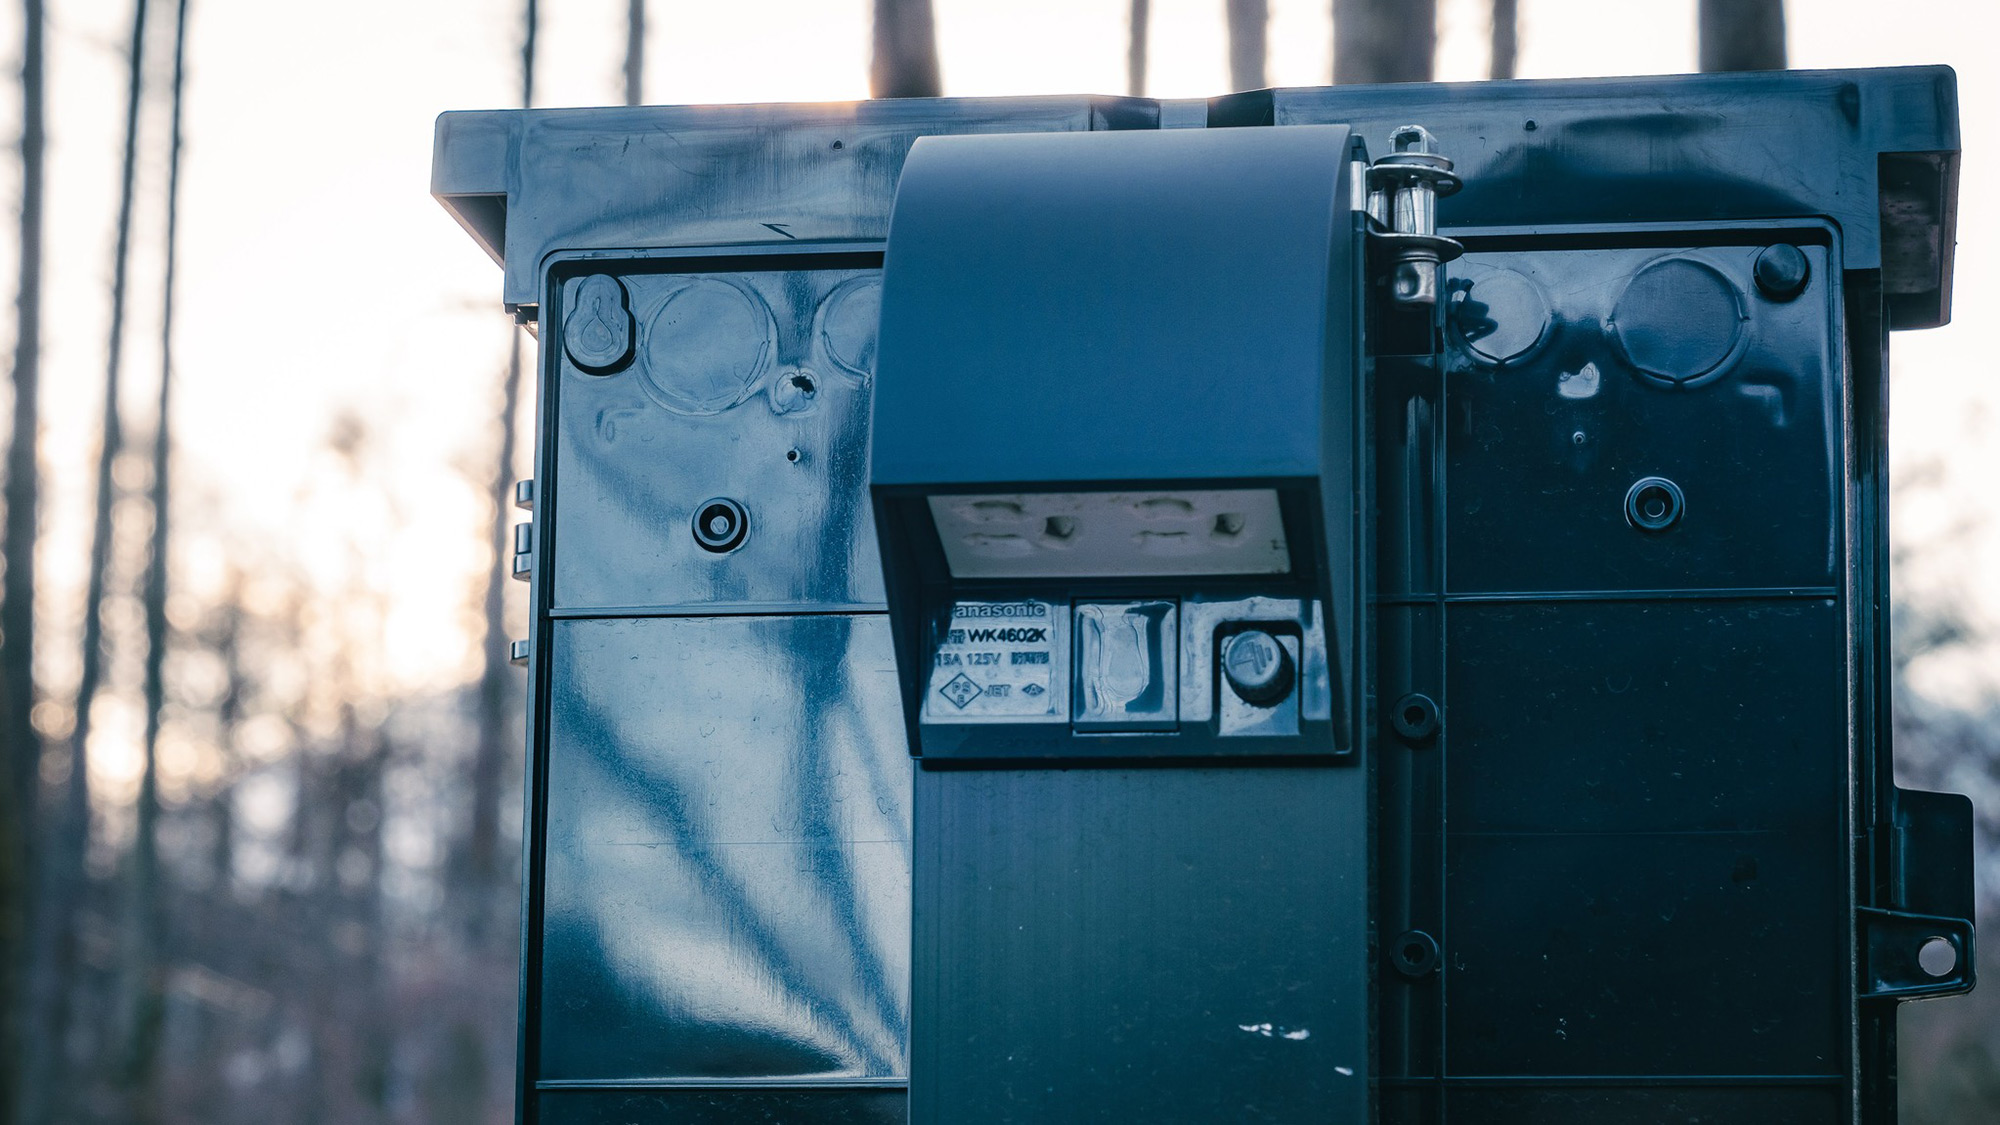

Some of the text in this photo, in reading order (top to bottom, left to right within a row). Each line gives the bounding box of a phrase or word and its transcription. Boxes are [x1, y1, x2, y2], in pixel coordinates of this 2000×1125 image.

[953, 601, 1046, 618] anasonic
[967, 627, 1047, 642] WK4602K
[936, 652, 1001, 666] 15A 125V
[983, 684, 1012, 698] JET
